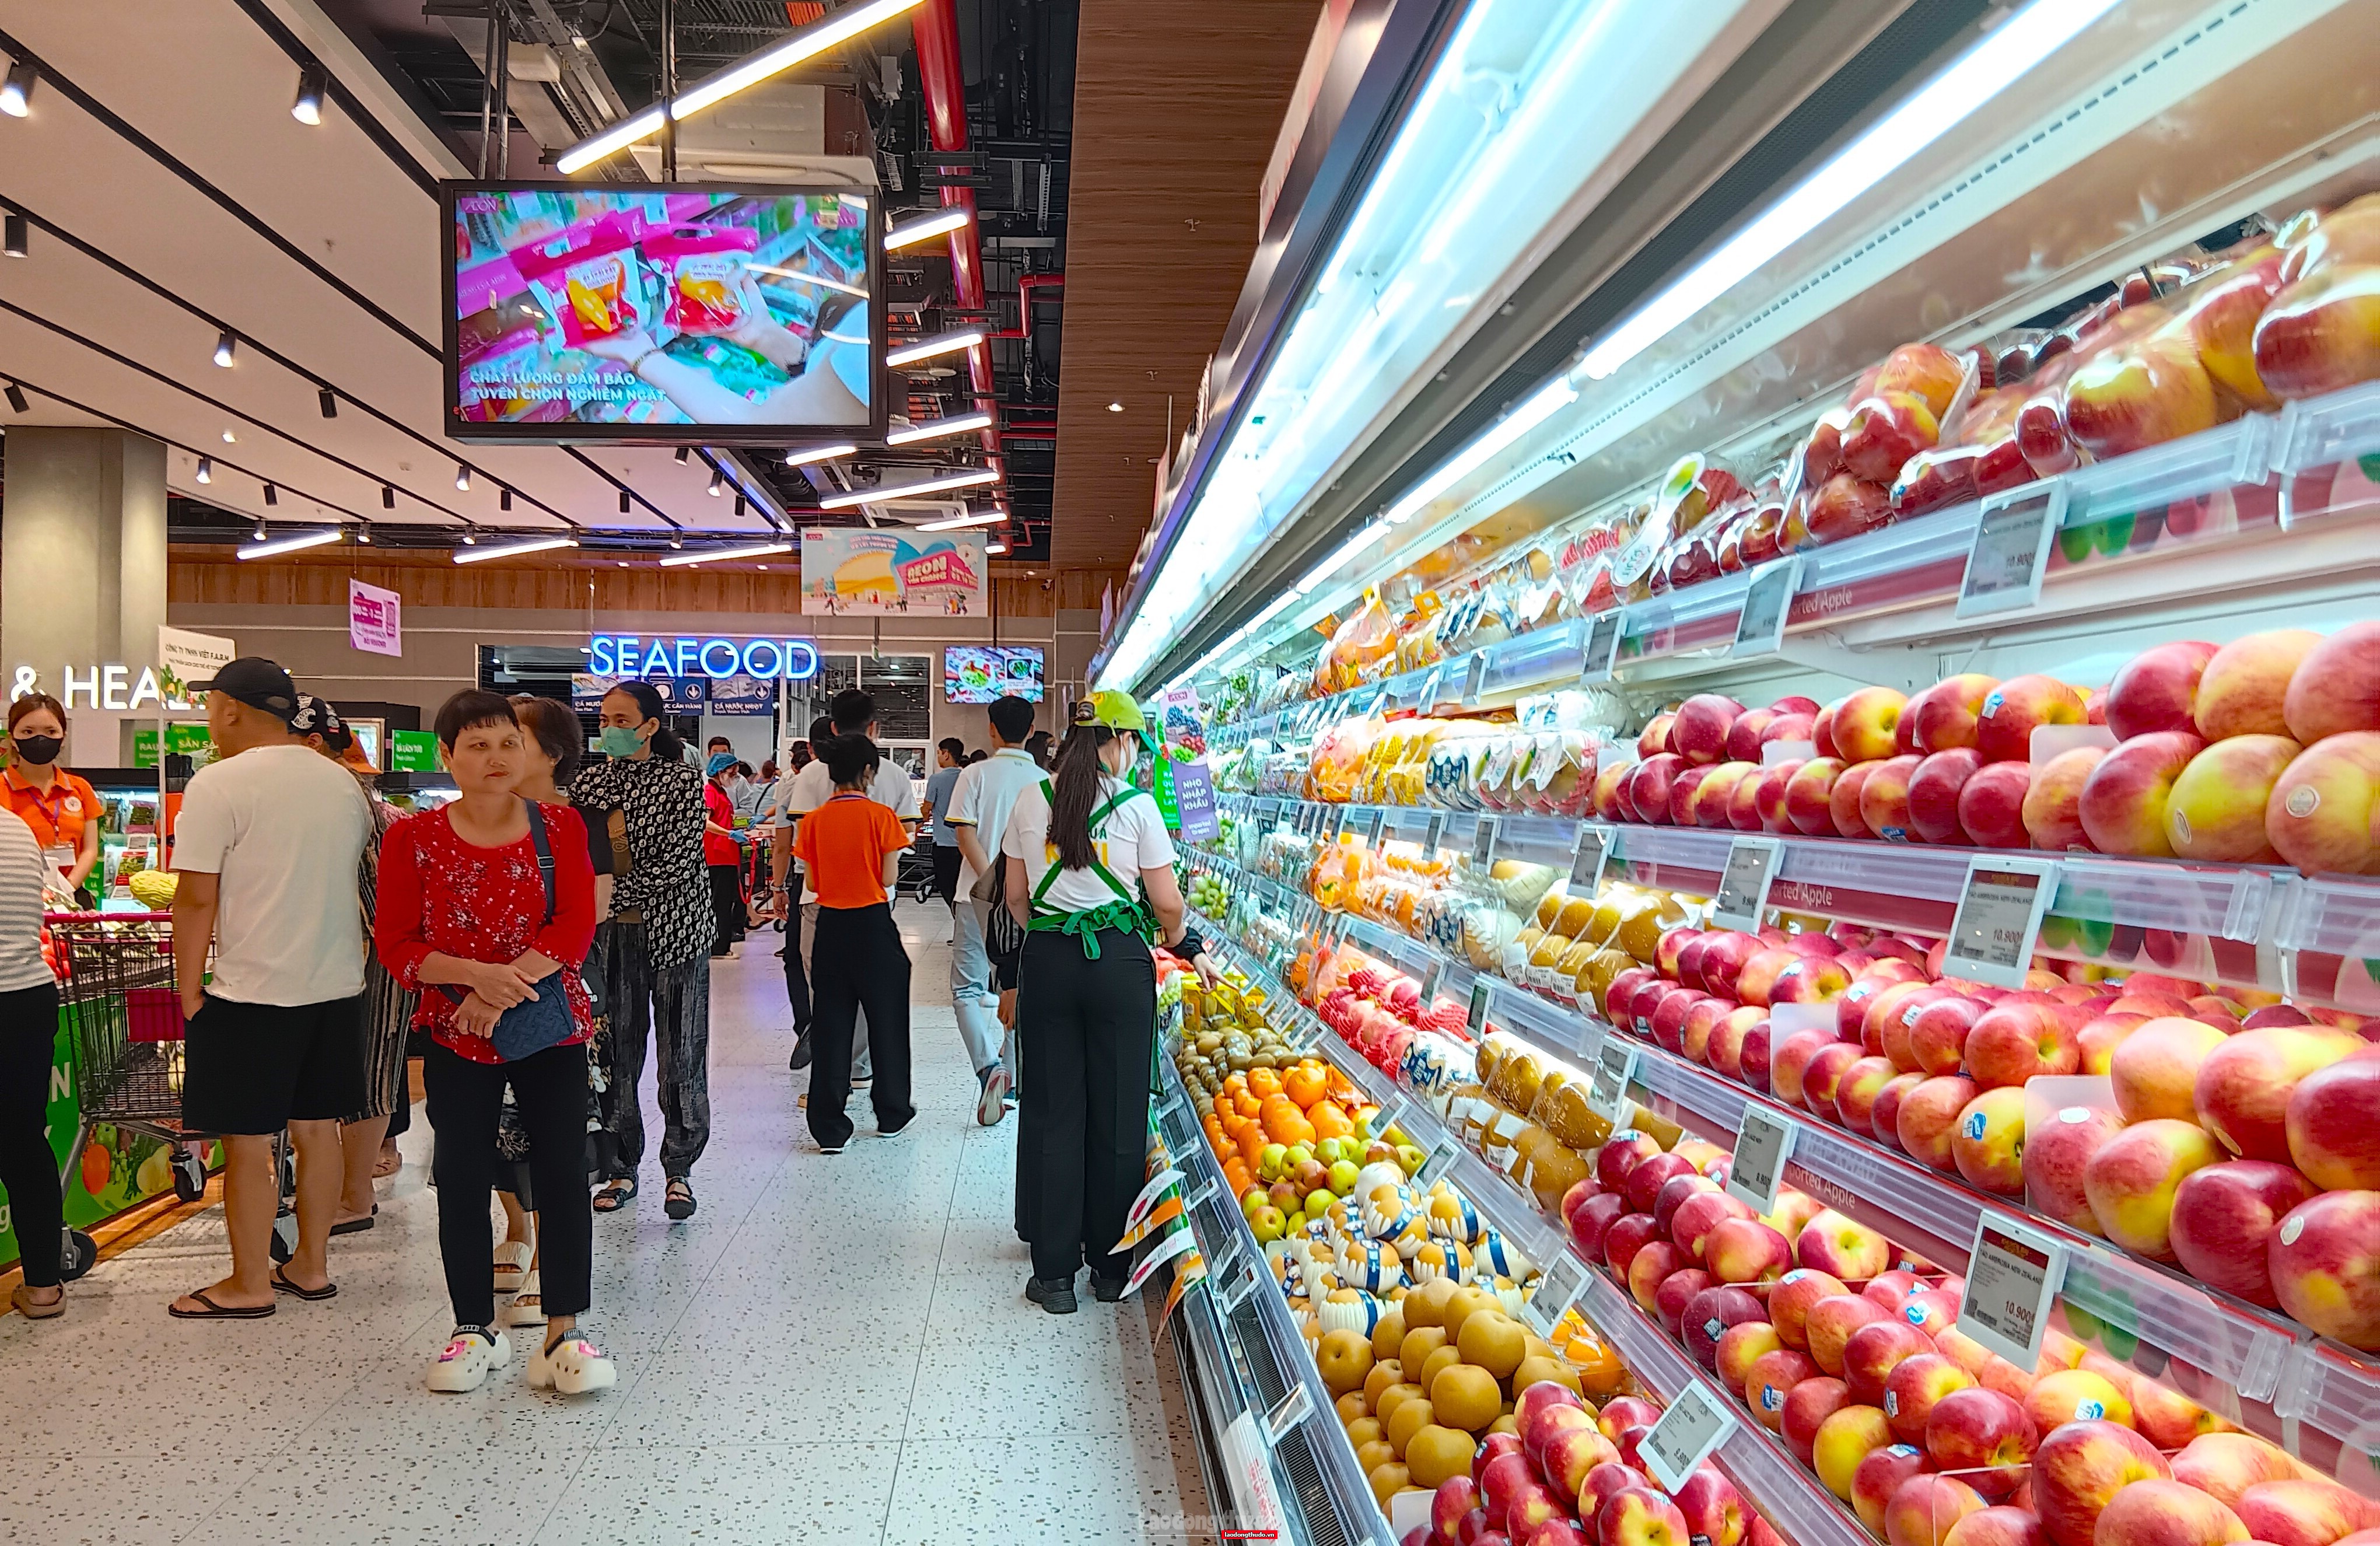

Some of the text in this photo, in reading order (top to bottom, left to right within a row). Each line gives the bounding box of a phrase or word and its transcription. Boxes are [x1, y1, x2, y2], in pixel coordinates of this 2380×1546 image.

[603, 369, 636, 385] BẢO
[523, 388, 563, 402] CHỌN
[908, 556, 947, 578] AEON
[1821, 586, 1853, 613] Apple
[589, 635, 817, 680] SEAFOOD
[1163, 779, 1175, 788] QU
[1182, 778, 1203, 790] NHO
[1800, 883, 1833, 907] Apple
[1824, 1180, 1856, 1209] Apple
